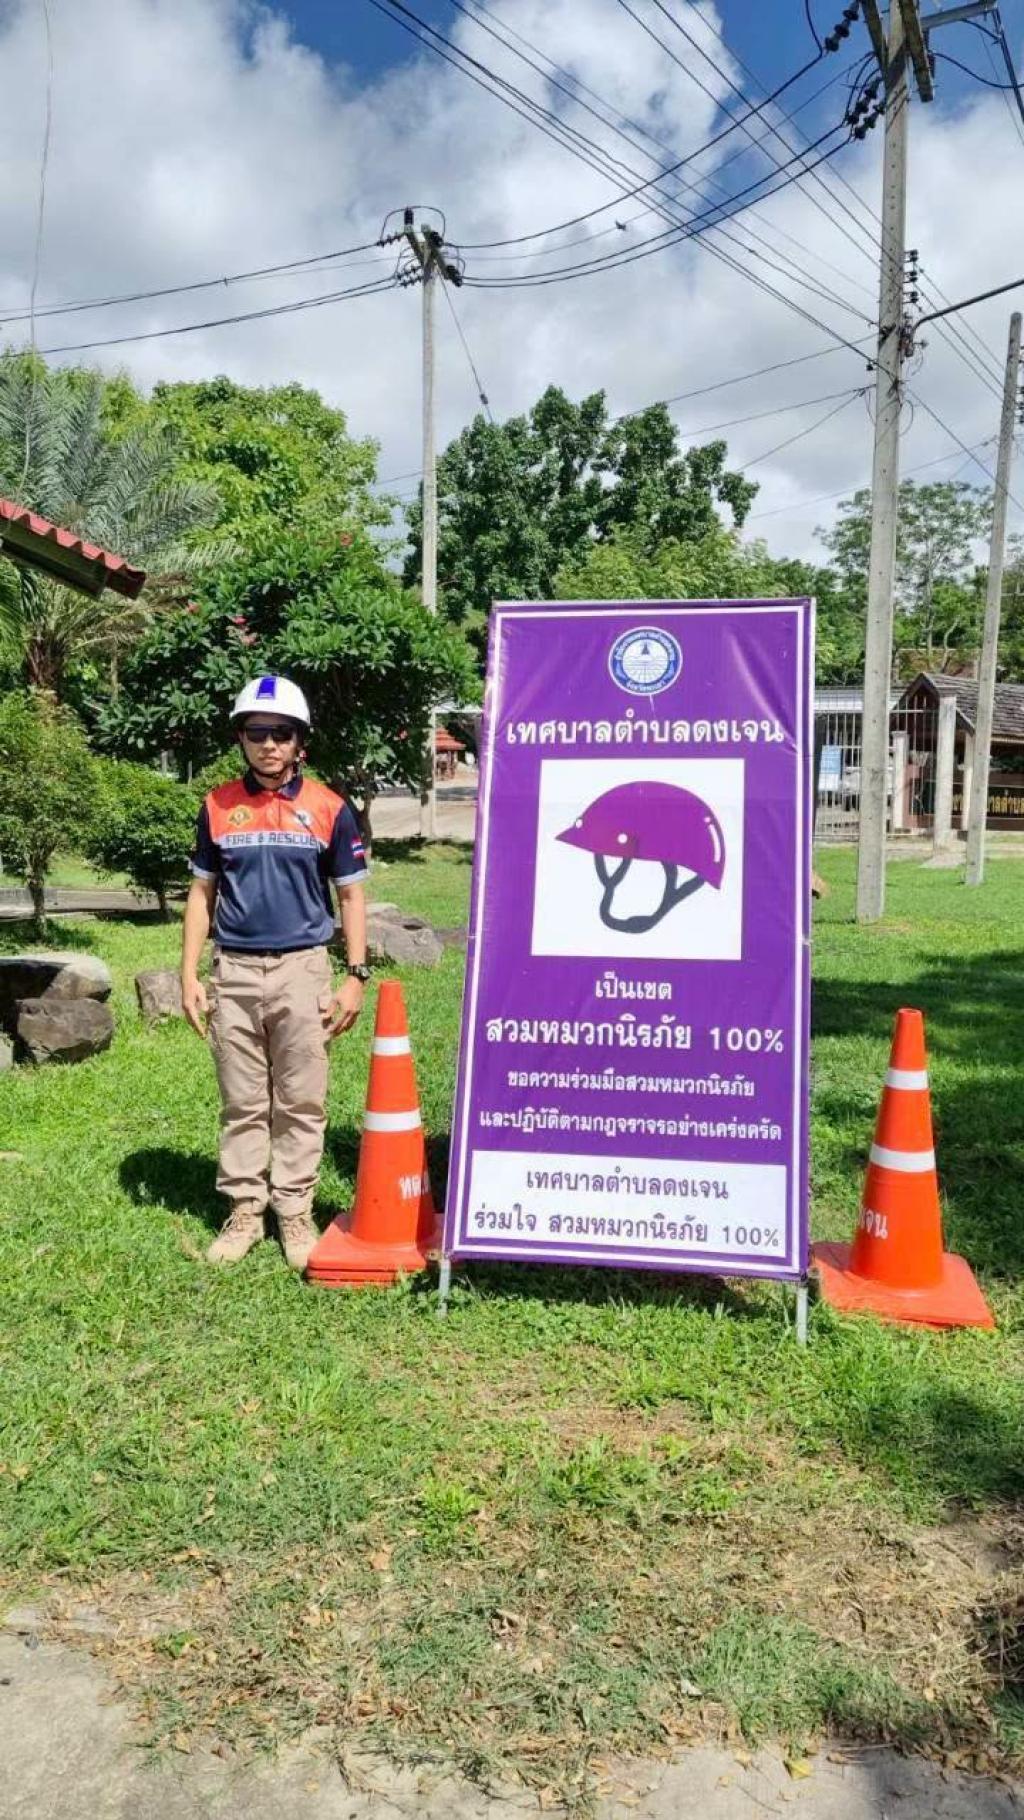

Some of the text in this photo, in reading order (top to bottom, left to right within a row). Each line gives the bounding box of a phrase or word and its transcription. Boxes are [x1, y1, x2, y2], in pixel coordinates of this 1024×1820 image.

[506, 708, 785, 745] เทศบาลตำบลดงเจน
[226, 832, 254, 848] FIRE
[268, 832, 318, 847] RESCUE
[594, 971, 673, 1001] เป็นเขต
[485, 1012, 785, 1054] สวมหมวกนิรภัย 100%
[507, 1067, 755, 1097] ขอความร่วมมือสวมหมวกนิรภัย
[526, 1166, 730, 1200] เทศบาลตำบลดงเจน
[473, 1203, 780, 1248] ร่วมใจ สวมหมวกนิรภัย 100%
